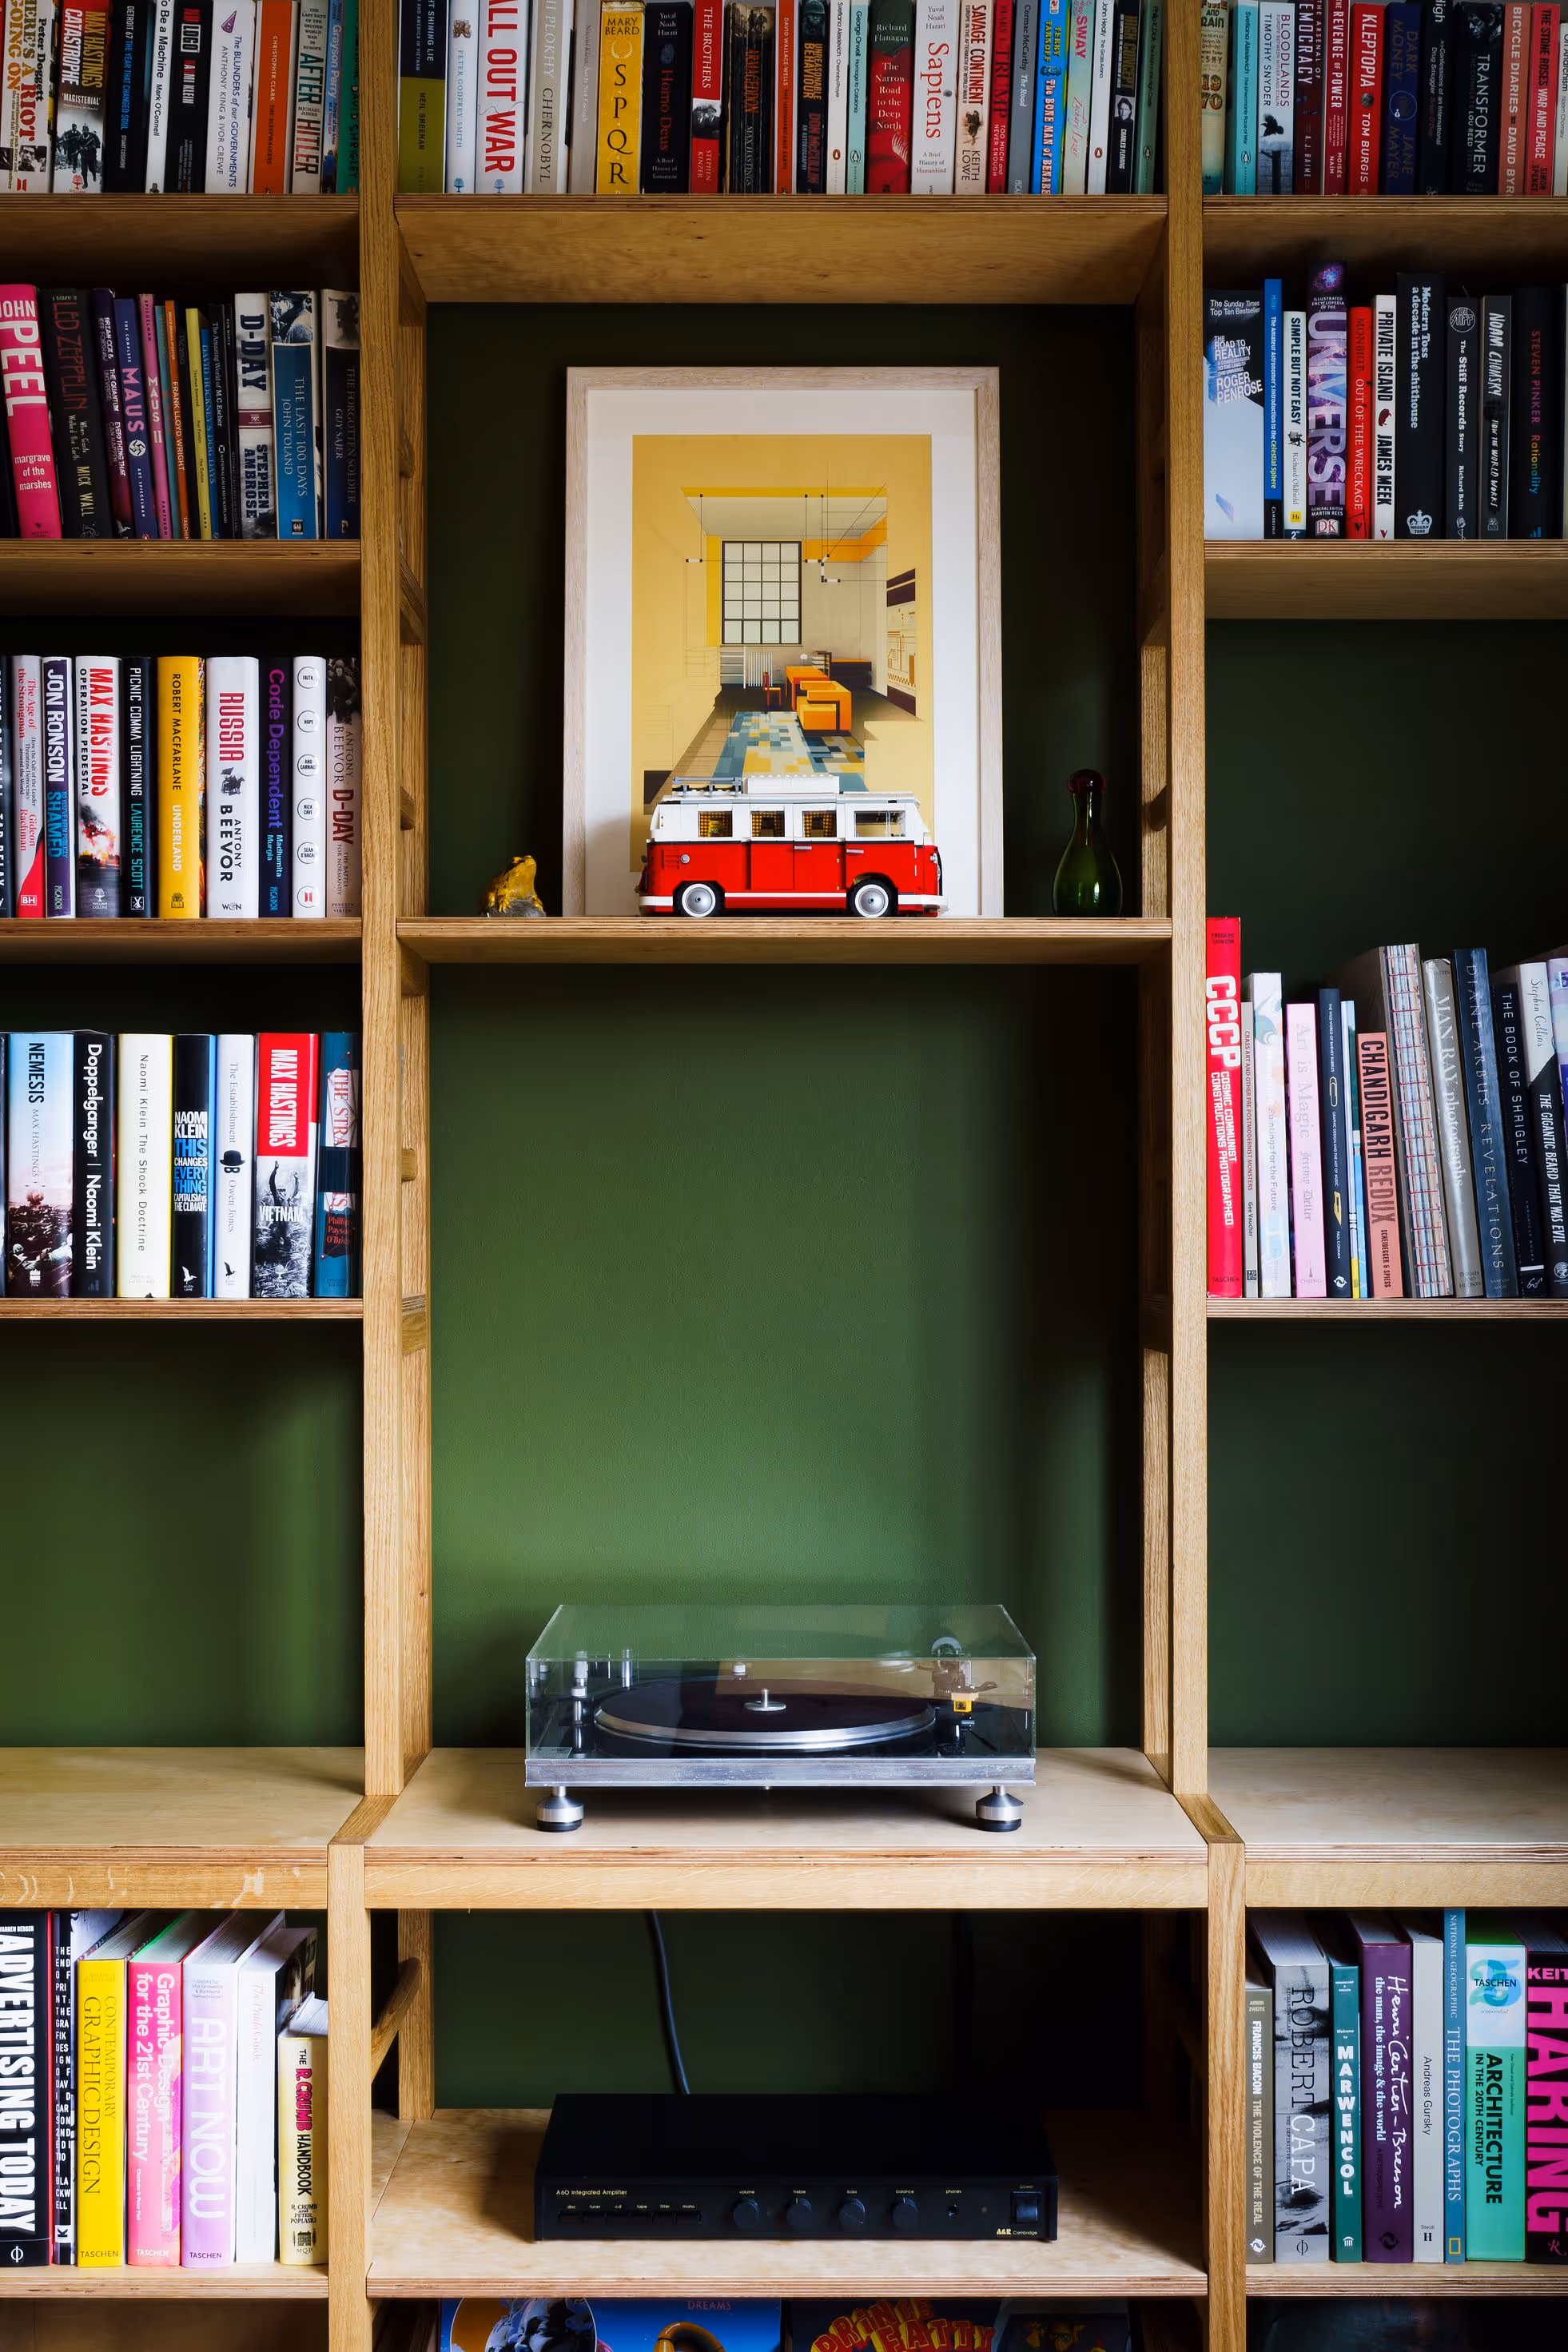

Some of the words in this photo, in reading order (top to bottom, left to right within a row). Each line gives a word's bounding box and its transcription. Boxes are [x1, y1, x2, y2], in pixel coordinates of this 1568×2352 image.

[38, 18, 46, 50] Peter
[85, 10, 105, 34] MAX
[703, 6, 712, 29] THE
[970, 5, 986, 44] SAVAGE
[1511, 6, 1522, 58] BICYCLE
[62, 8, 82, 86] CATASTROPHE
[81, 36, 104, 88] HASTINGS
[702, 32, 712, 89] BROTHERS
[1279, 14, 1290, 107] BLOODLANDS
[1360, 14, 1377, 87] KLEPTOPIA
[35, 54, 46, 101] Doggett
[233, 51, 241, 96] BLUNDERS
[298, 53, 324, 105] AFTER
[486, 49, 518, 101] OUT
[920, 42, 949, 138] Sapiens
[969, 49, 985, 105] CONTINENT
[1509, 62, 1520, 113] DIARIES
[231, 98, 240, 107] of
[1361, 113, 1371, 137] TOM
[1473, 54, 1490, 173] TRANSFORMER
[229, 121, 238, 188] GOVERNMENTS
[295, 118, 320, 174] HITLER
[485, 110, 515, 173] WAR
[539, 88, 553, 183] CHERNOBYL
[961, 150, 970, 181] LOWE
[972, 150, 981, 181] KEITH
[1360, 140, 1369, 182] BURGIS
[1422, 287, 1431, 332] Modern
[1489, 312, 1506, 347] NOAM
[241, 314, 266, 391] D-DAY
[1291, 317, 1300, 354] SIMPLE
[1377, 311, 1394, 357] PRIVATE
[1422, 333, 1431, 358] Toss
[0, 320, 46, 416] PEEL
[1291, 356, 1300, 374] BUT
[1291, 377, 1300, 398] NOT
[1377, 361, 1394, 400] ISLAND
[1459, 356, 1467, 383] Stiff
[1487, 351, 1502, 396] CHOMSKY
[294, 376, 305, 403] THE
[1290, 400, 1300, 424] EASY
[1307, 310, 1347, 505] UNIVERSE
[1458, 385, 1467, 430] Records
[281, 399, 292, 428] JOHN
[295, 408, 306, 436] LAST
[14, 455, 51, 464] margrave
[283, 432, 293, 475] TOLAND
[296, 440, 307, 460] 100
[1377, 434, 1392, 471] JAMES
[76, 466, 91, 486] MICK
[245, 448, 257, 519] AMBROSE
[257, 444, 269, 508] STEPHEN
[297, 465, 308, 496] DAYS
[1377, 475, 1392, 505] MEEK
[79, 493, 94, 516] WALL
[46, 669, 64, 706] JON
[90, 668, 113, 706] MAX
[129, 667, 141, 701] PICNIC
[269, 669, 285, 720] Code
[130, 706, 141, 740] COMMA
[220, 692, 244, 761] RUSSIA
[46, 711, 65, 782] RONSON
[90, 714, 113, 796] HASTINGS
[173, 718, 181, 790] MACFARLANE
[130, 745, 142, 796] LIGHTNING
[266, 723, 284, 828] Dependent
[131, 803, 142, 854] LAURENCE
[172, 805, 181, 871] UNDERLAND
[220, 805, 233, 882] BEEVOR
[131, 858, 142, 889] SCOTT
[1205, 976, 1241, 1068] CCCP
[1502, 993, 1514, 1019] THE
[270, 1049, 297, 1080] MAX
[1505, 1026, 1518, 1063] BOOK
[29, 1043, 45, 1103] NEMESIS
[139, 1055, 149, 1092] Naomi
[1220, 1071, 1233, 1106] COSMIC
[1510, 1071, 1521, 1088] OF
[83, 1044, 104, 1157] Doppelganger
[139, 1098, 148, 1128] Klein
[269, 1082, 297, 1147] HASTINGS
[1211, 1072, 1227, 1148] CONSTRUCTIONS
[1360, 1040, 1387, 1159] CHANDIGARH
[1540, 1093, 1552, 1109] THE
[139, 1134, 148, 1154] The
[1225, 1108, 1237, 1162] COMMUNIST
[1511, 1096, 1528, 1164] SHRIGLEY
[1542, 1112, 1556, 1149] GIGANTIC
[138, 1160, 148, 1195] Shock
[1218, 1150, 1234, 1226] PHOTOGRAPHED
[1544, 1152, 1559, 1180] BEARD
[86, 1175, 101, 1227] Naomi
[258, 1205, 304, 1222] VIETNAM
[1547, 1184, 1560, 1203] THAT
[1550, 1206, 1562, 1223] WAS
[137, 1201, 147, 1252] Doctrine
[1552, 1225, 1565, 1244] EVIL
[86, 1231, 102, 1269] Klein
[136, 1972, 153, 2003] for
[154, 1972, 176, 2046] Graphic
[0, 1935, 34, 2129] ADVERTISING
[136, 2005, 153, 2037] the
[1252, 2020, 1262, 2060] FRANCIS
[82, 1996, 101, 2103] GRAPHIC
[105, 1996, 116, 2119] CONTEMPORARY
[137, 2041, 153, 2079] 21st
[189, 2017, 225, 2100] ART
[298, 2049, 307, 2065] THE
[1290, 1988, 1315, 2109] ROBERT
[1447, 2027, 1461, 2063] THE
[1475, 2053, 1484, 2063] IN
[1252, 2063, 1262, 2095] BACON
[1423, 2056, 1432, 2096] Andreas
[1475, 2067, 1484, 2087] THE
[132, 2083, 153, 2161] Century
[296, 2068, 312, 2131] R.CRUMB
[1421, 2099, 1434, 2135] Gursky
[1475, 2090, 1484, 2116] 20TH
[1447, 2070, 1462, 2202] PHOTOGRAPHS
[1474, 2119, 1484, 2167] CENTURY
[1486, 2053, 1502, 2203] ARCHITECTURE
[82, 2108, 101, 2194] DESIGN
[189, 2111, 225, 2218] NOW
[296, 2134, 312, 2195] HANDBOOK
[1291, 2115, 1315, 2194] CAPA
[0, 2138, 34, 2231] TODAY
[688, 2301, 731, 2310] DREAMS
